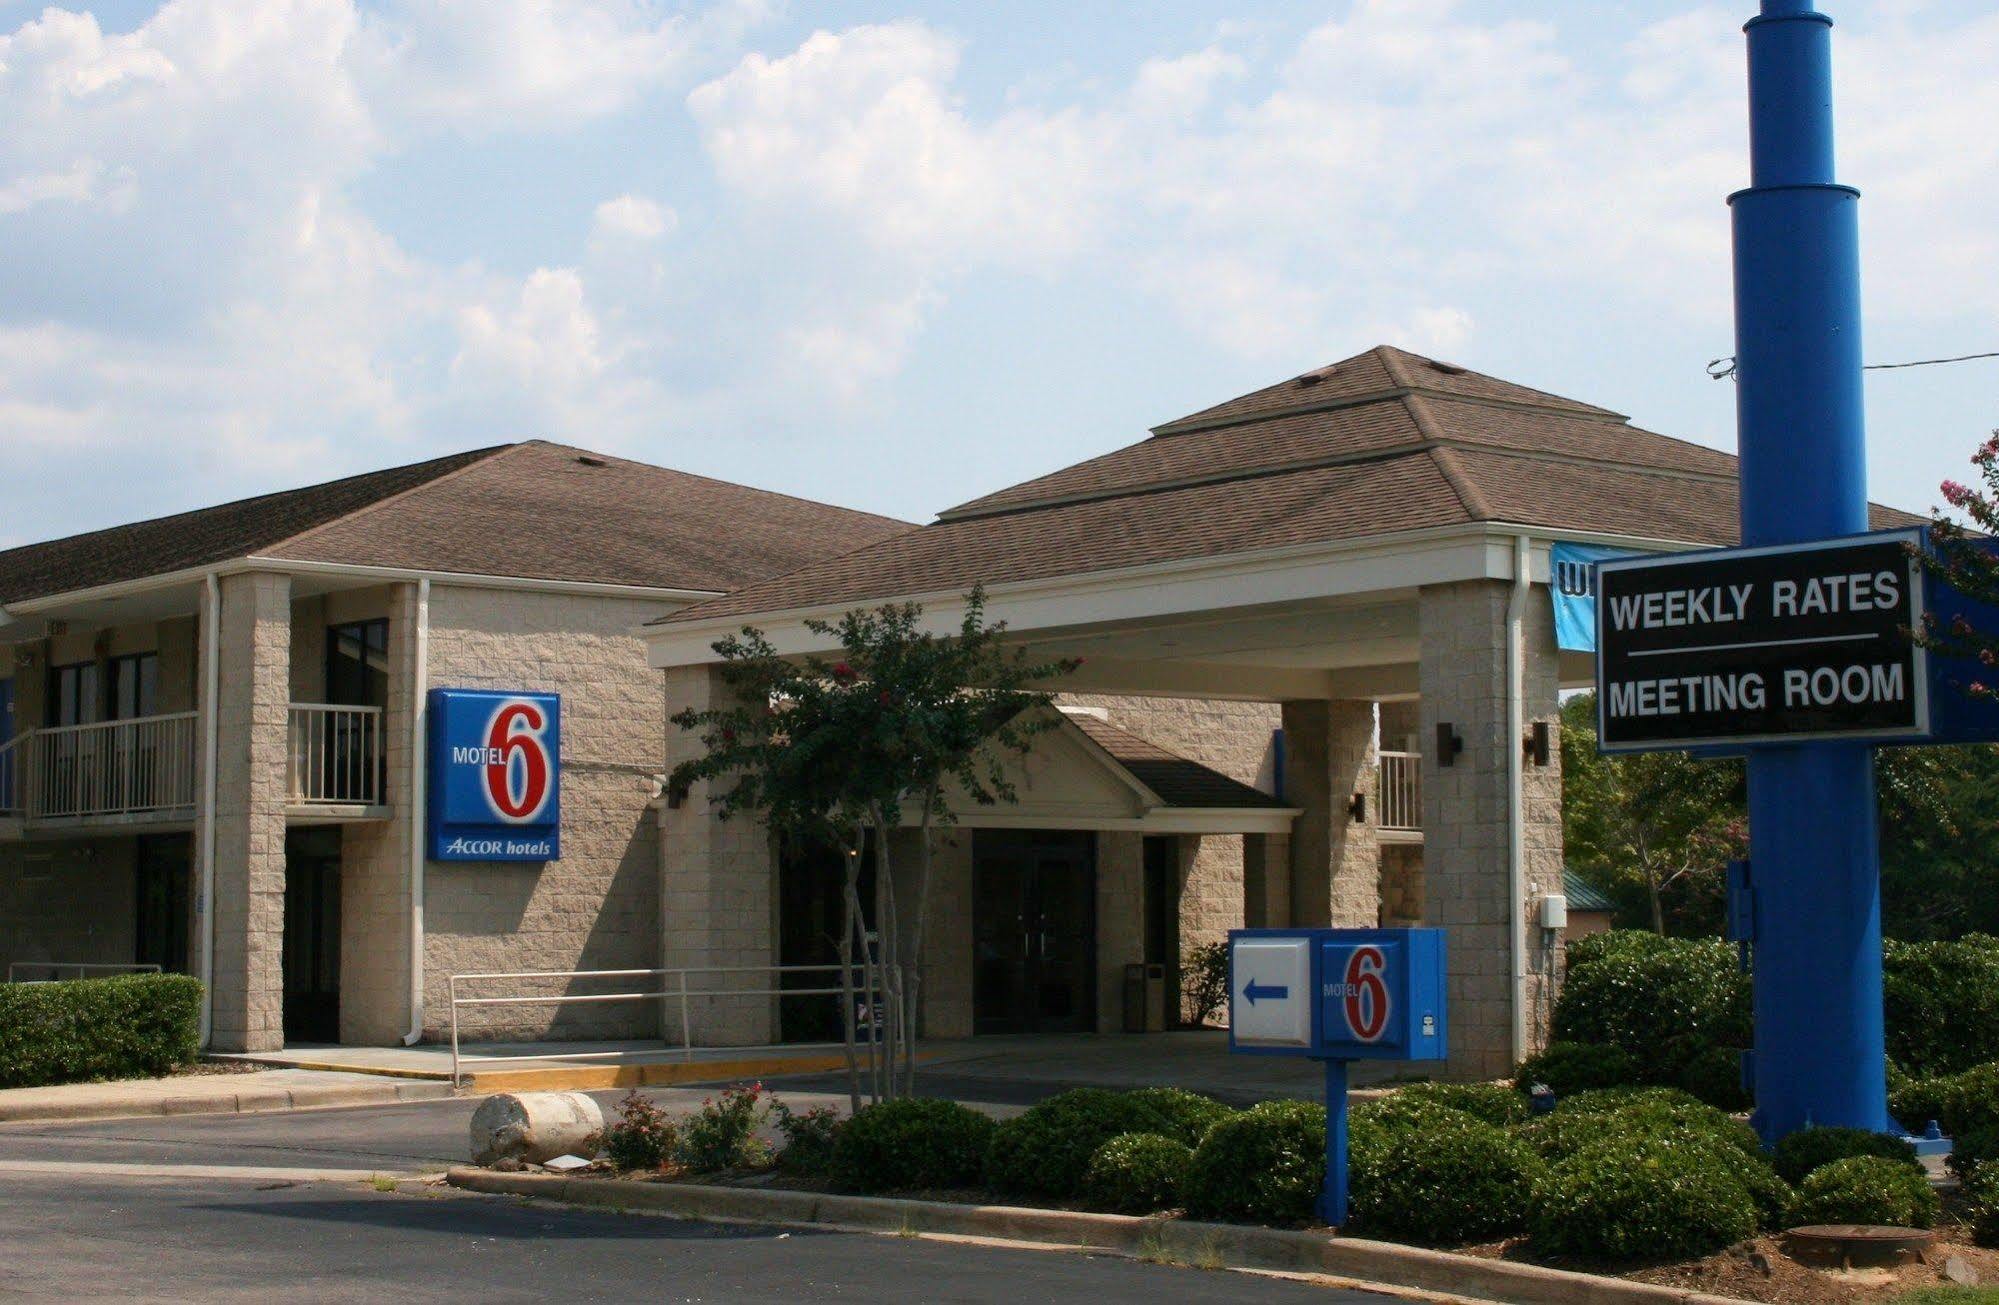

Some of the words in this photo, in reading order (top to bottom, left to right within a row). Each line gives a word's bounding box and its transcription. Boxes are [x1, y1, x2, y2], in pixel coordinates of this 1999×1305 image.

[1610, 583, 1754, 631] WEEKLY
[1772, 570, 1900, 618] RATES
[1609, 672, 1766, 718] MEETING
[1783, 663, 1905, 706] ROOM
[453, 746, 508, 766] MOTEL
[485, 702, 548, 820] 6
[447, 837, 503, 855] ACCOR
[506, 840, 551, 856] hotels
[1323, 983, 1359, 998] MOTEL
[1345, 946, 1388, 1040] 6
